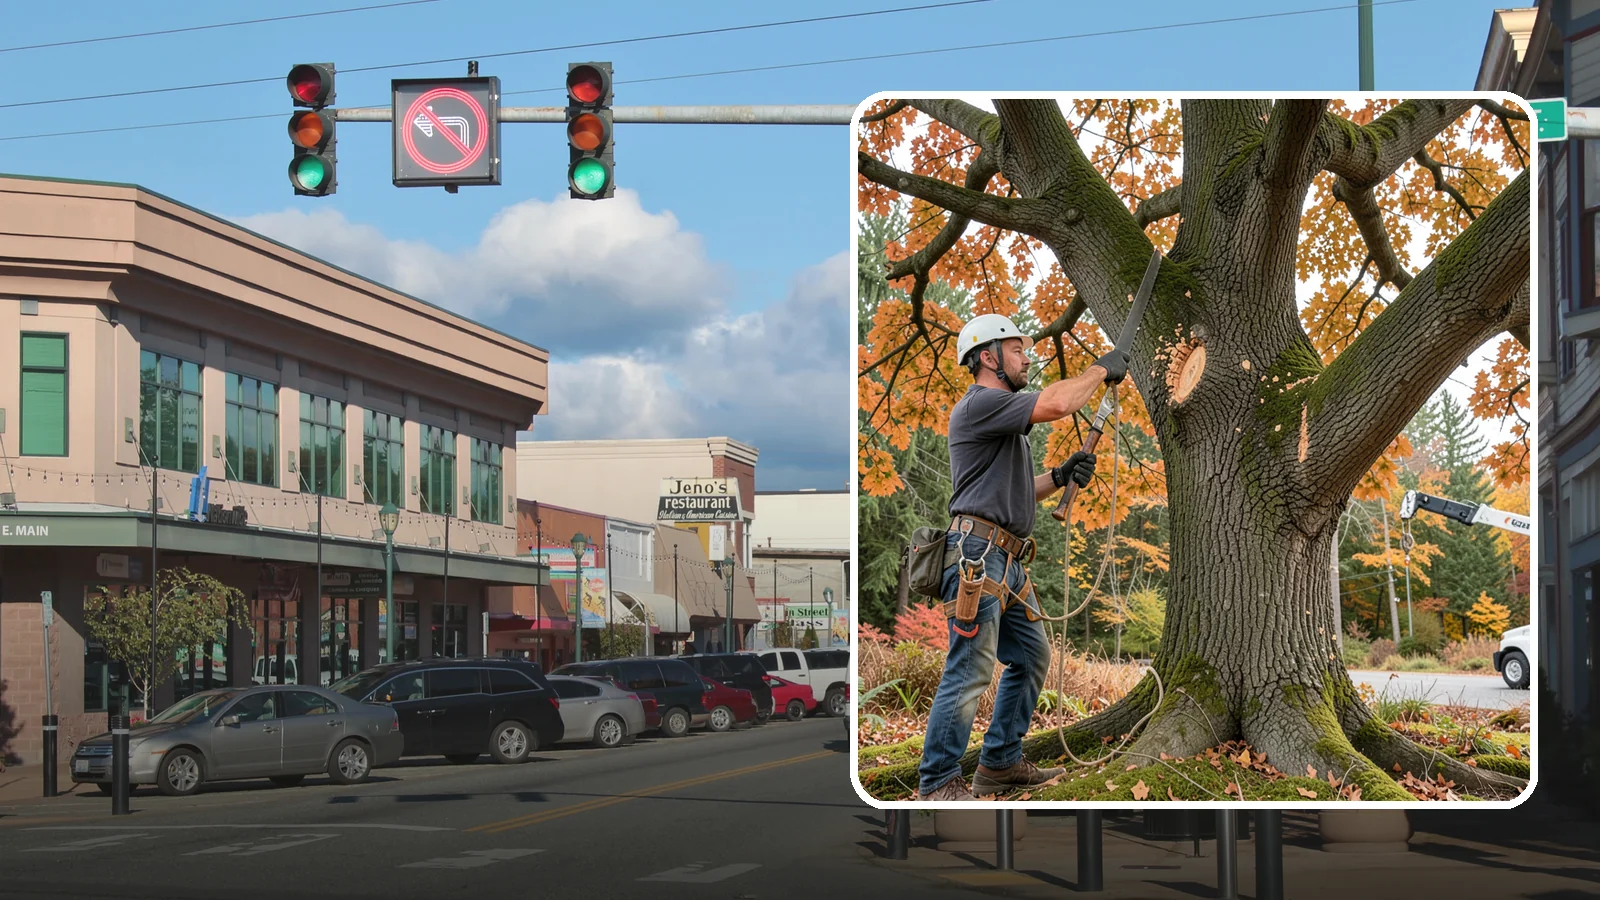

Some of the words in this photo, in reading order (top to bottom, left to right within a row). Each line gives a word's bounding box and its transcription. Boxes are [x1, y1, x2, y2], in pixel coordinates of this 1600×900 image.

[670, 480, 727, 495] Jeno's
[665, 496, 731, 509] restaurant
[658, 509, 681, 519] Italian
[686, 509, 714, 519] American
[715, 509, 737, 519] Cuisine
[2, 525, 13, 536] E.
[15, 525, 49, 536] MAIN
[797, 607, 828, 616] Street
[791, 619, 823, 627] lass
